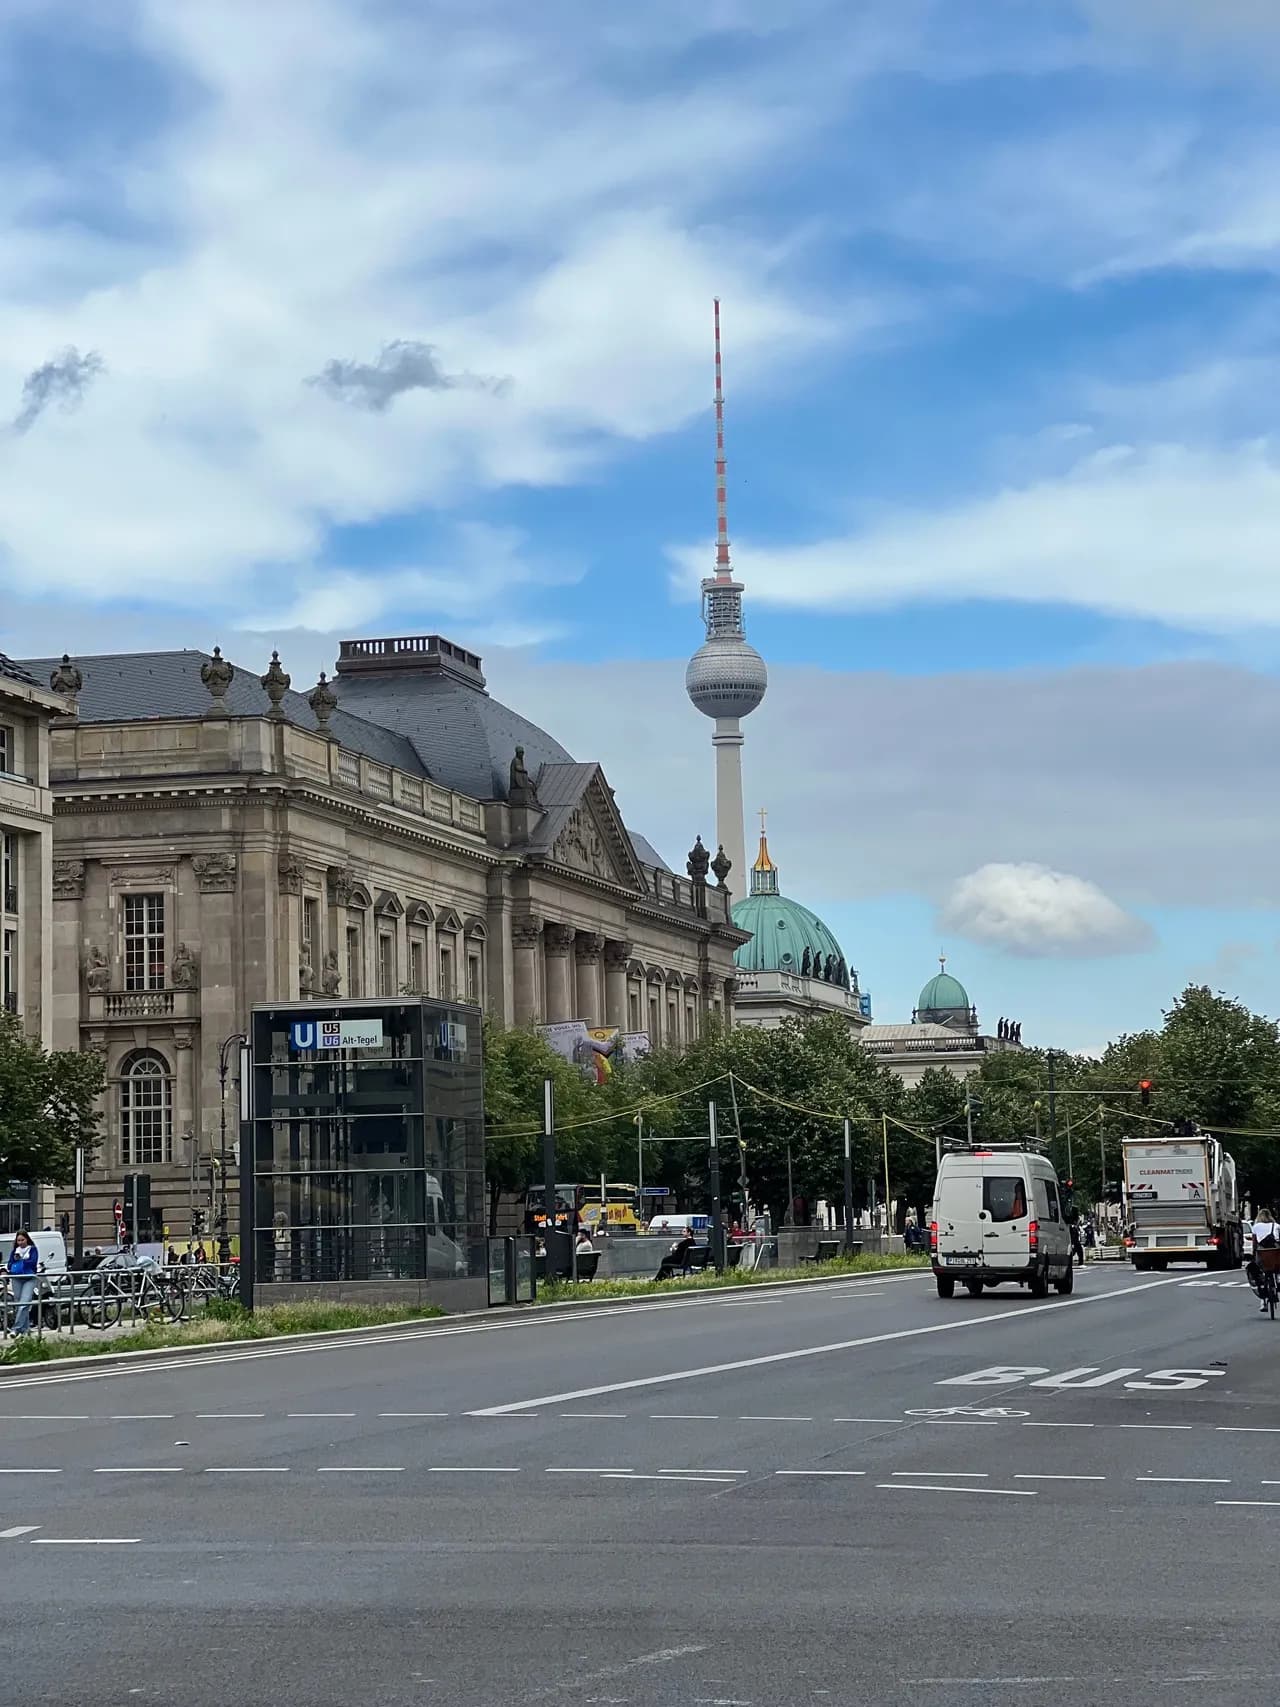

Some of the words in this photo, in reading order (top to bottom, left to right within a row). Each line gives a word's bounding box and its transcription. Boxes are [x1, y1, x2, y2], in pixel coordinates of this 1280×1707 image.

[324, 1024, 339, 1033] U5
[294, 1023, 314, 1048] U
[324, 1036, 339, 1046] U6
[342, 1035, 378, 1046] Alt-Tegel
[1193, 1189, 1201, 1199] A
[933, 1366, 1226, 1391] BUS
